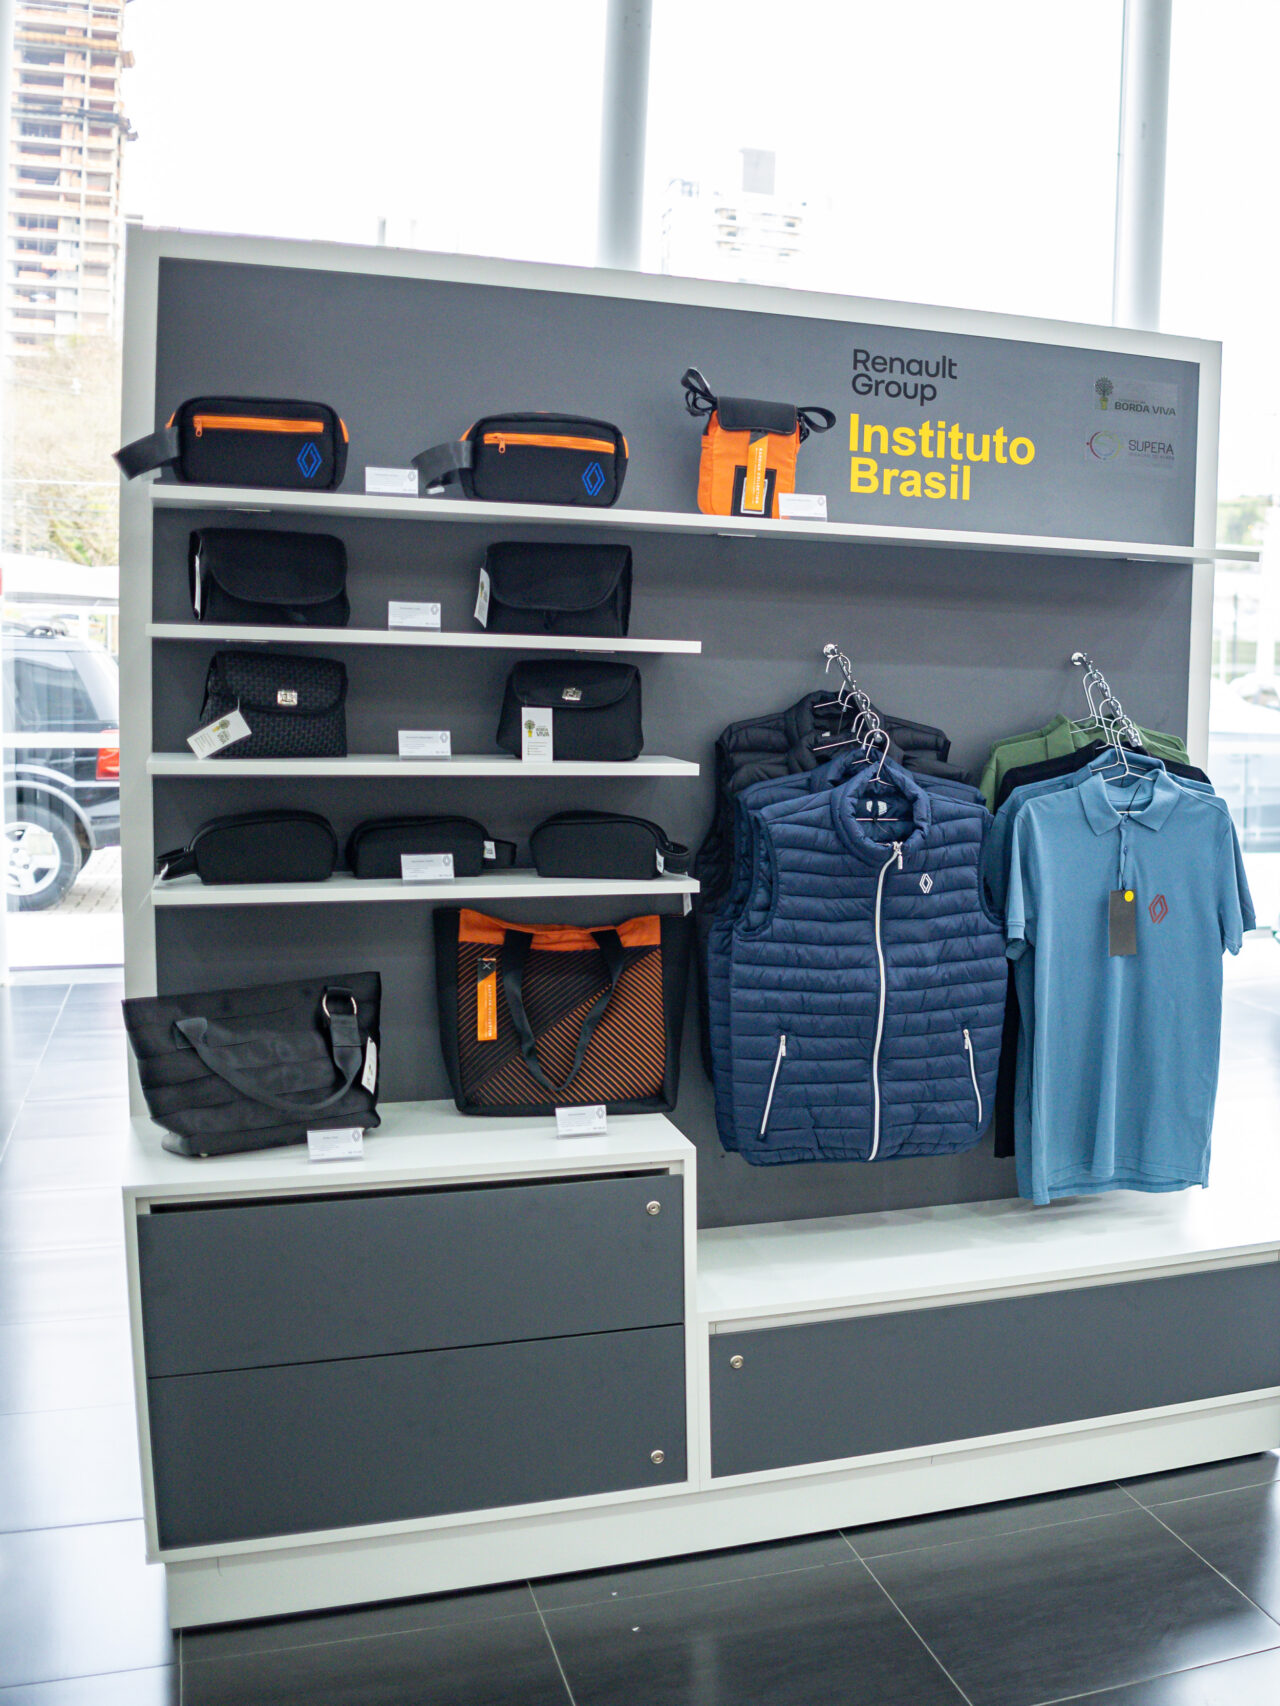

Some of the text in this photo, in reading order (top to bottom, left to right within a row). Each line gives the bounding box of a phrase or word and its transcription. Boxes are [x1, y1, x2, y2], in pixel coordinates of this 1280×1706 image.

[853, 349, 958, 380] Renault
[852, 373, 937, 406] Group
[1114, 401, 1150, 413] BORDA
[1152, 405, 1176, 416] VIVA
[849, 413, 1035, 465] Instituto
[1128, 439, 1174, 455] SUPERA
[850, 457, 970, 501] Brasil
